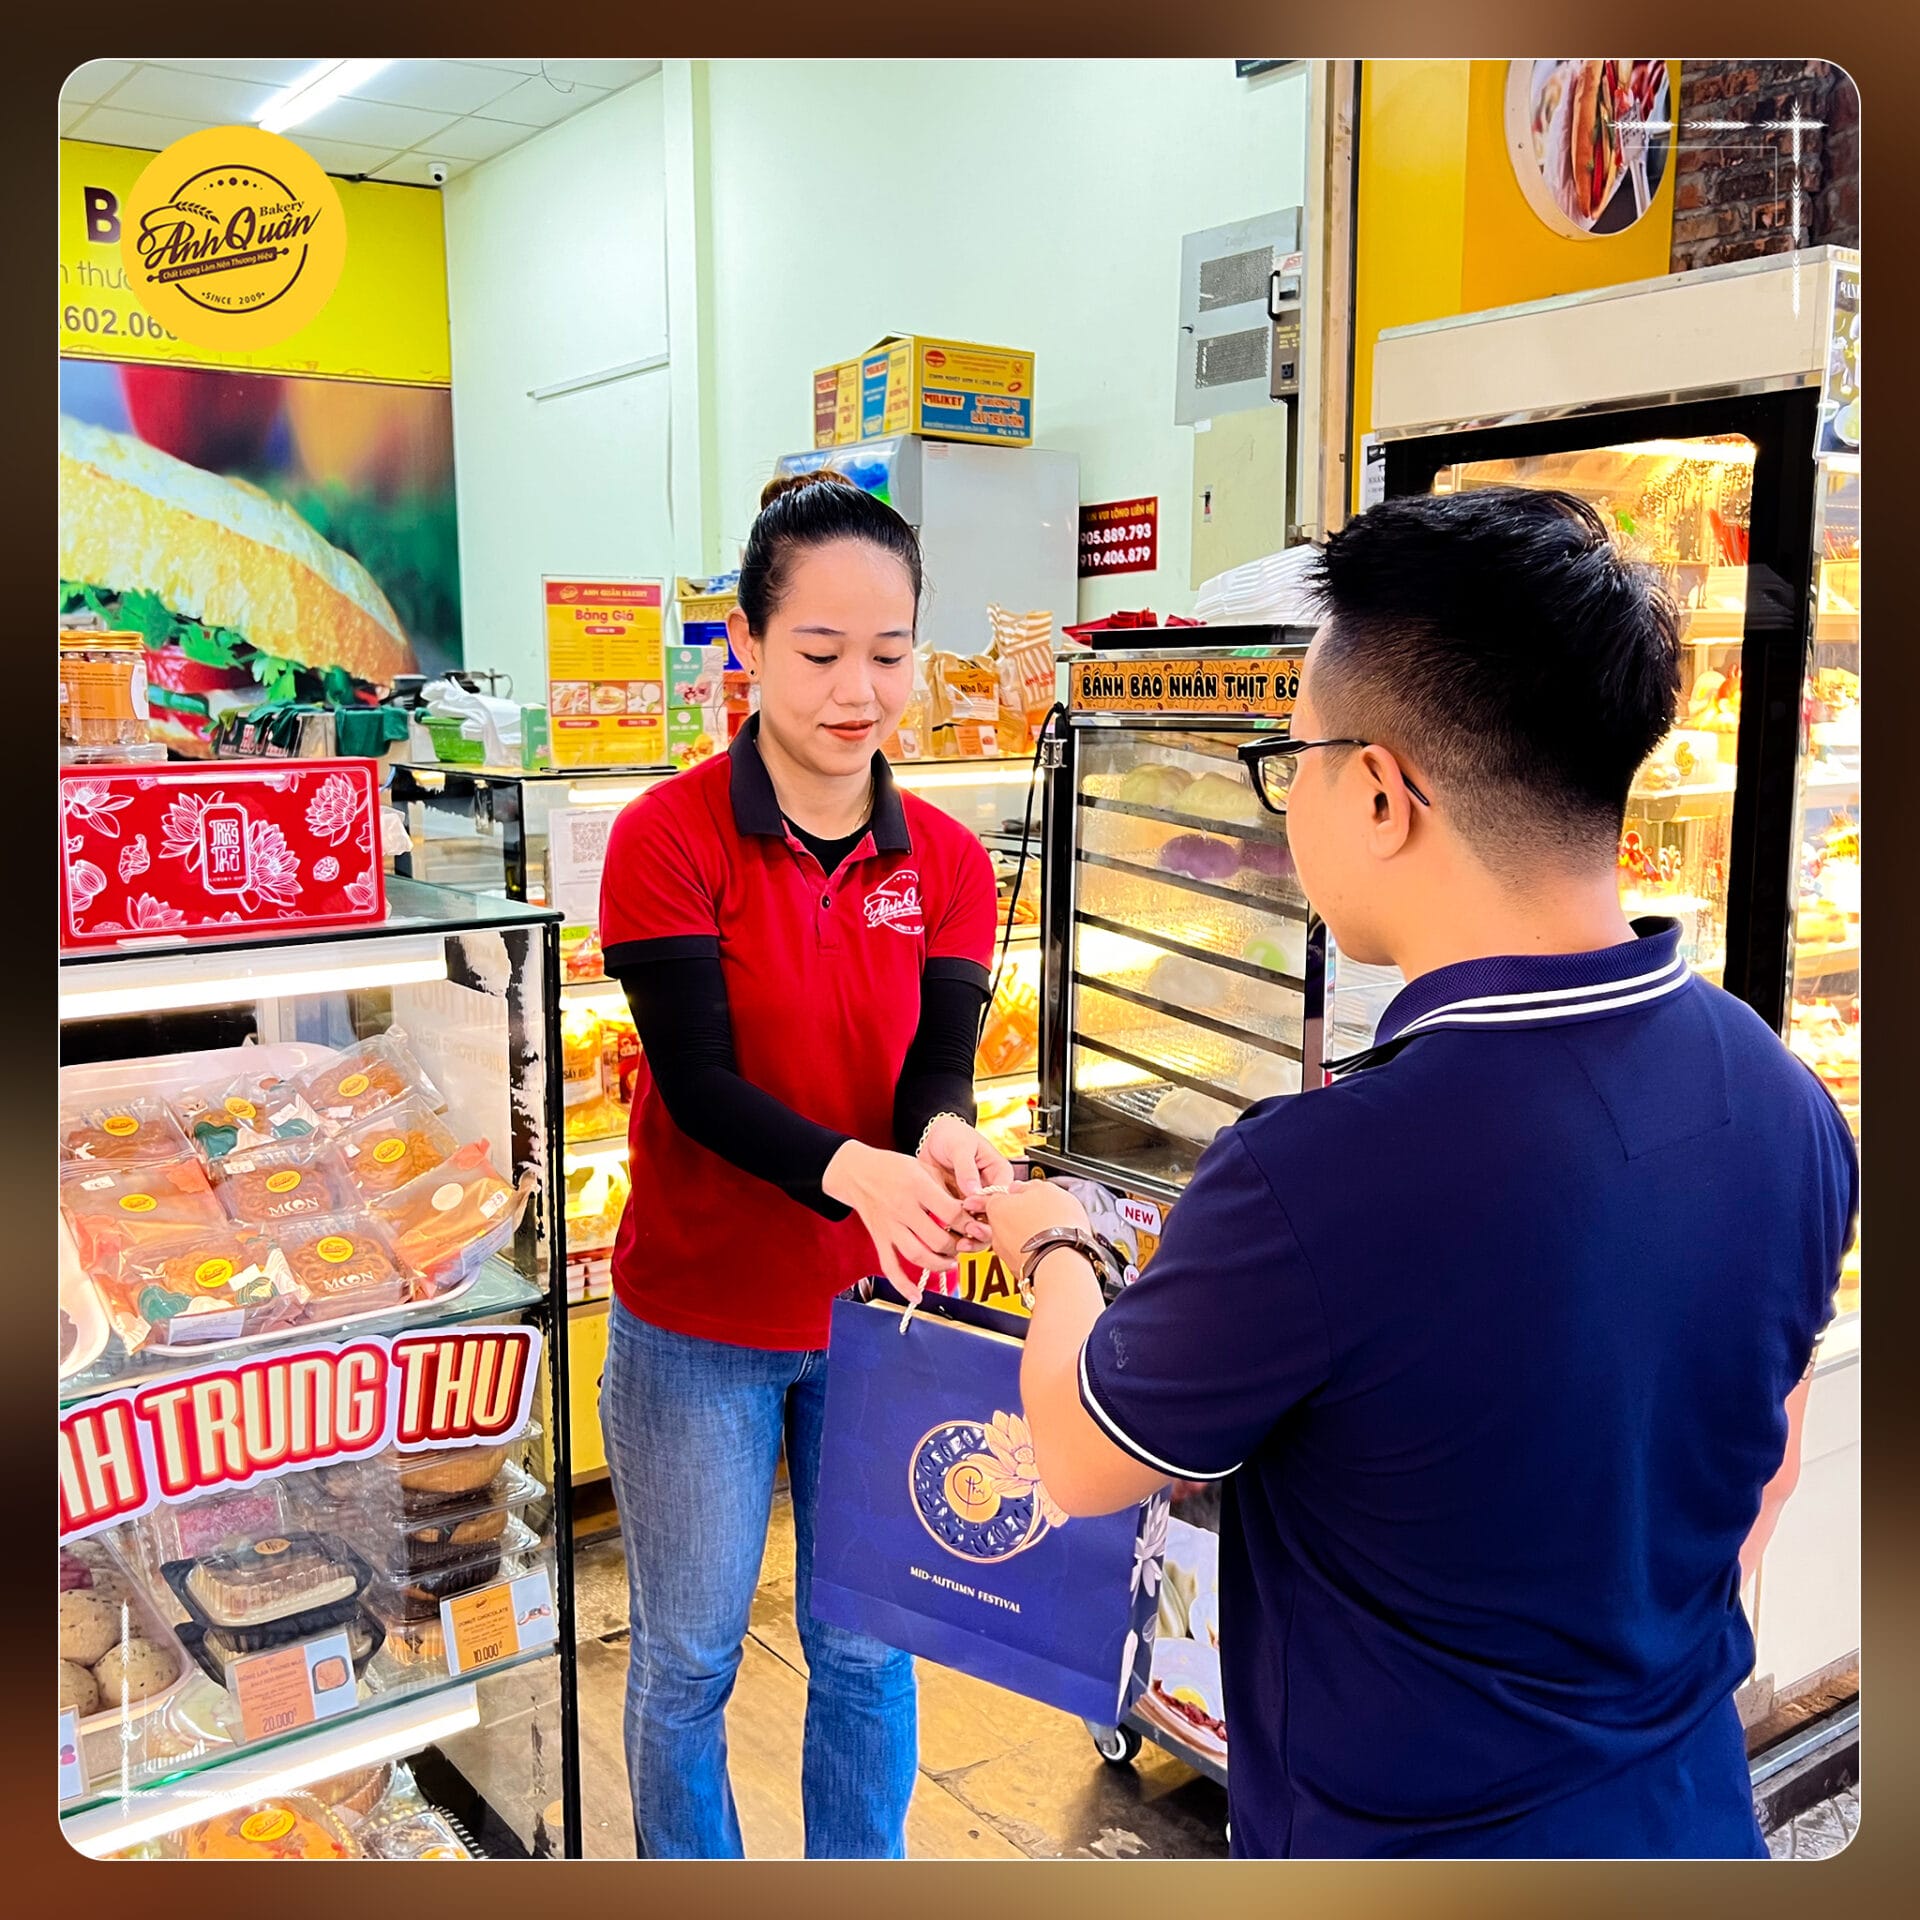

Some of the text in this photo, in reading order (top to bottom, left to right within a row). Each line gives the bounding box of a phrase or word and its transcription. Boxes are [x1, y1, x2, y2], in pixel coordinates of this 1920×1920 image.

[575, 608, 634, 624] Bảng Giá
[1082, 670, 1124, 698] BÁNH
[1130, 673, 1163, 698] BAO
[1169, 670, 1218, 699] NHÂN
[1224, 674, 1269, 704] THỊT
[268, 1197, 319, 1217] MOON
[1125, 1206, 1154, 1225] NEW
[323, 1271, 375, 1292] MOON
[144, 1351, 377, 1486] TRUNG
[398, 1339, 518, 1435] THU
[910, 1566, 1022, 1613] MID-AUTUMN FESTIVAL
